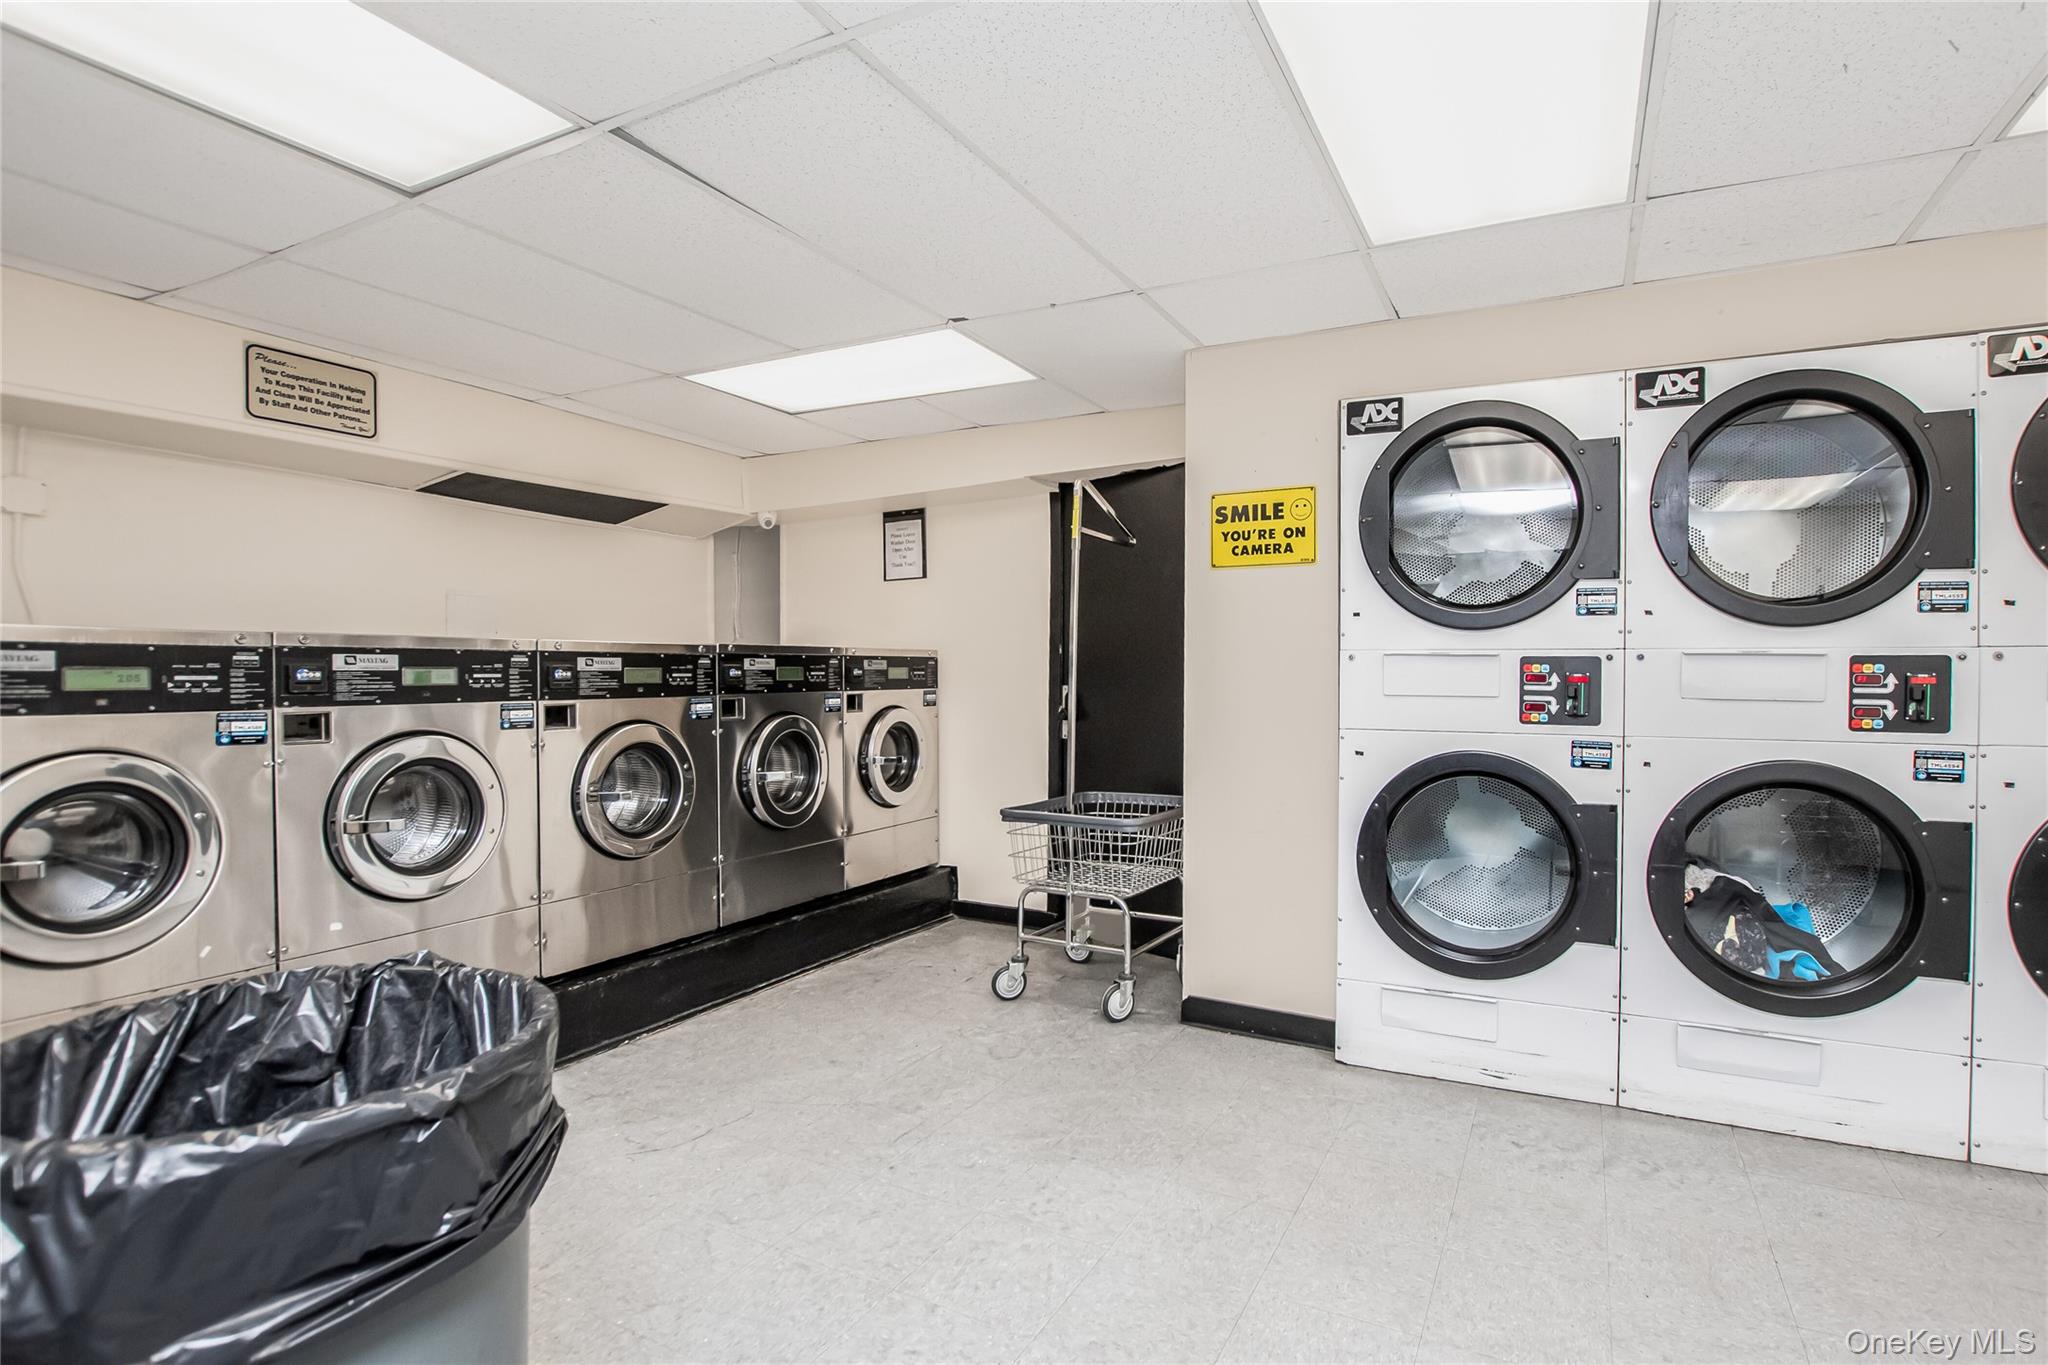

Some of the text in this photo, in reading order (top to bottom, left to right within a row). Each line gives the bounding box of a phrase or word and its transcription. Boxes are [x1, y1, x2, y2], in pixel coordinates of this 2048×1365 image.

[260, 366, 366, 396] Your Cooperation In Helping
[263, 377, 363, 404] To Keep This Facility Neat
[1653, 371, 1699, 396] ADC
[255, 386, 370, 415] And Clean Will Be Appreciated
[259, 397, 269, 406] By
[271, 399, 291, 409] Staff
[292, 404, 309, 413] And
[310, 407, 332, 417] Other
[1360, 401, 1399, 424] ADC
[1215, 502, 1284, 524] SMILE
[1221, 527, 1306, 542] YOU'RE ON
[1232, 543, 1294, 556] CAMERA
[0, 654, 40, 662] AYTAG
[358, 657, 389, 665] MAYTAG
